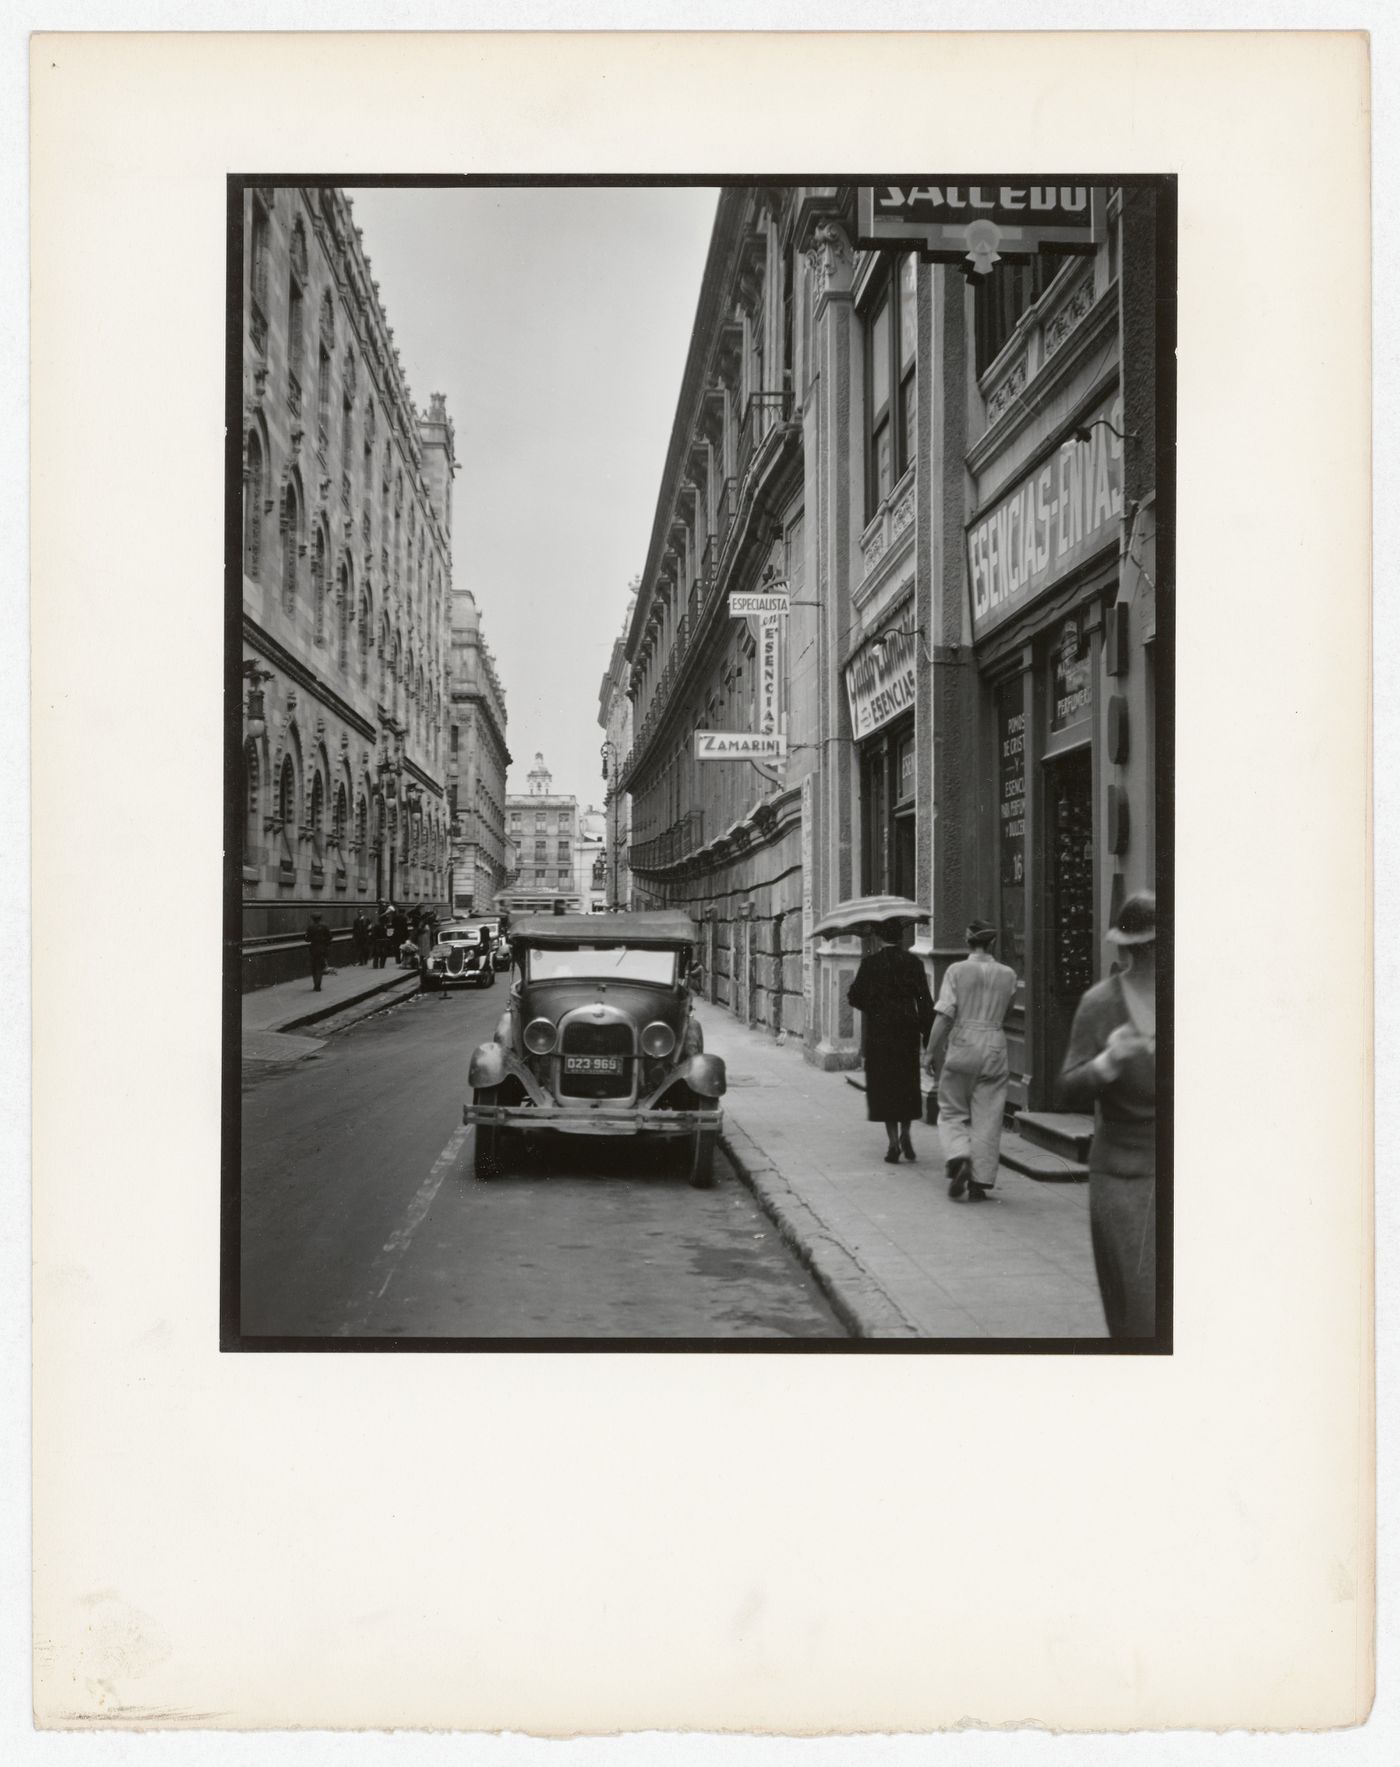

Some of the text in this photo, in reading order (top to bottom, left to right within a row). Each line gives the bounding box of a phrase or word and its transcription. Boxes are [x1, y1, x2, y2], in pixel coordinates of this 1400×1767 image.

[732, 597, 788, 611] ESPECIALISTA
[763, 628, 775, 735] ESENCIAS
[870, 669, 915, 725] ESENCIAS
[567, 1058, 591, 1069] 023
